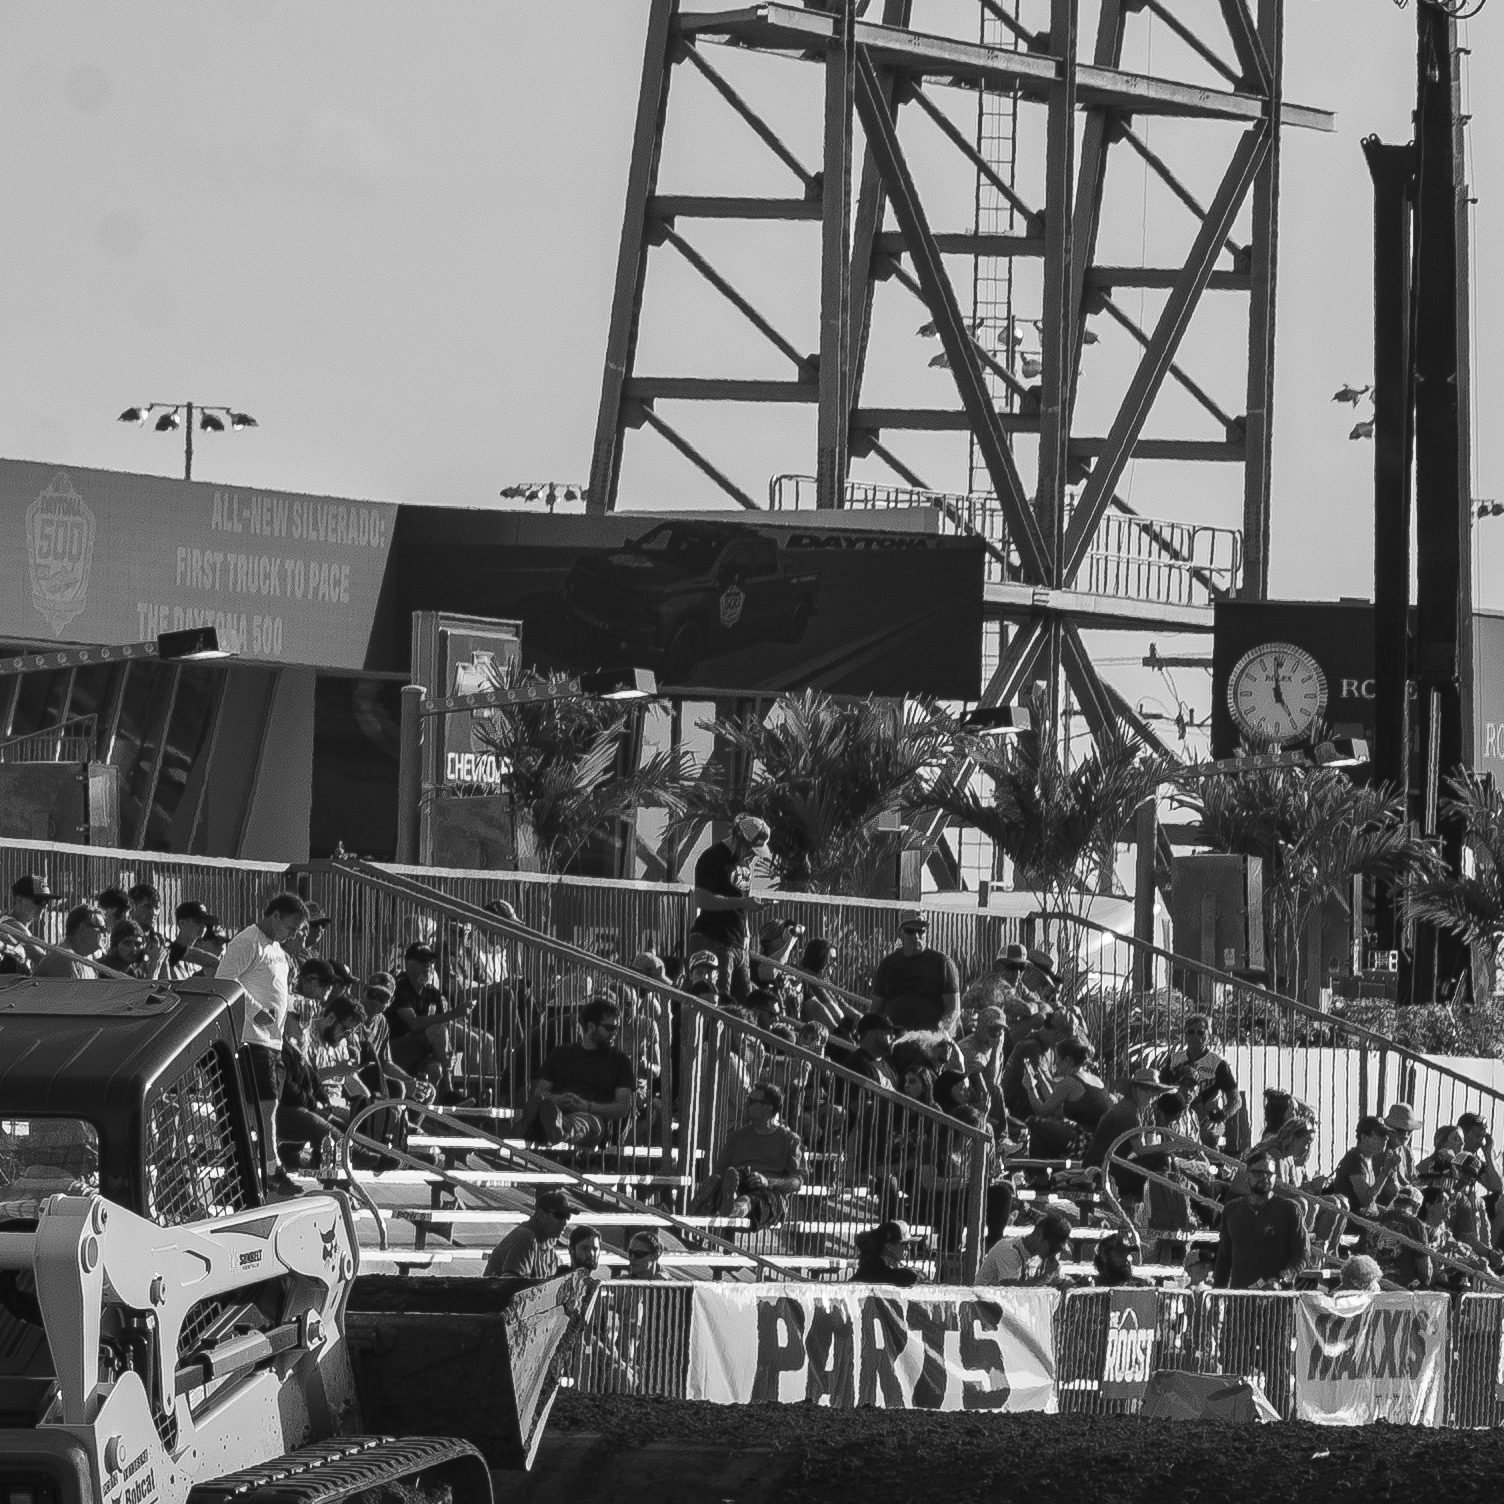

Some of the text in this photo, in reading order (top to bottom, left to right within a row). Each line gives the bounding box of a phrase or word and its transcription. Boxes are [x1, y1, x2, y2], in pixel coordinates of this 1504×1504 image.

[174, 545, 350, 603] FIRST TRUCK TO PACE
[251, 615, 283, 654] 500
[752, 1298, 1010, 1408] PARTS
[1103, 1328, 1155, 1383] ROOST
